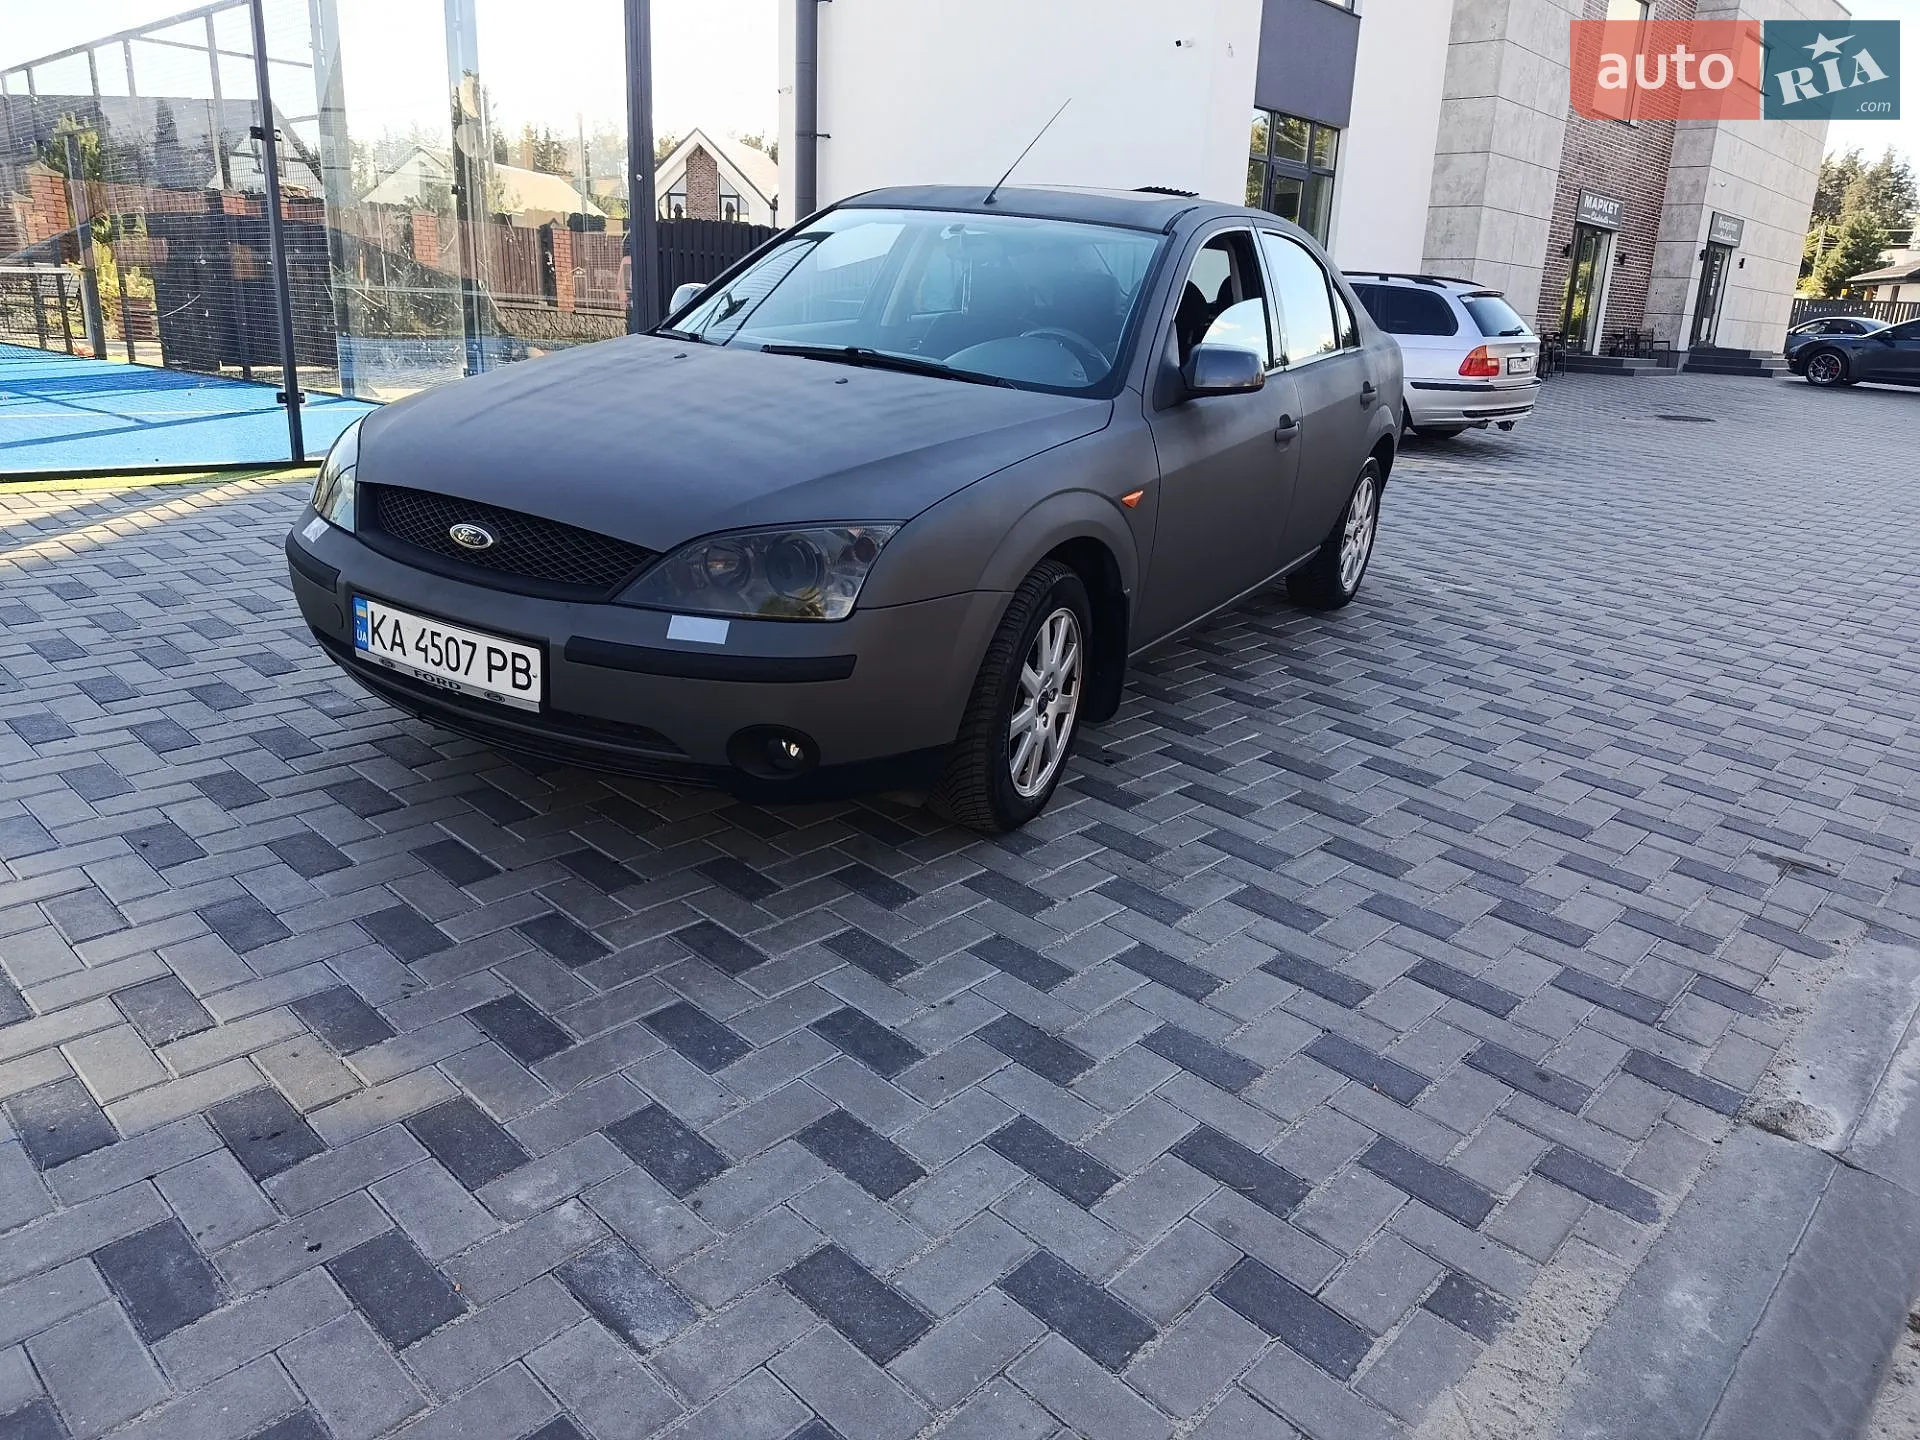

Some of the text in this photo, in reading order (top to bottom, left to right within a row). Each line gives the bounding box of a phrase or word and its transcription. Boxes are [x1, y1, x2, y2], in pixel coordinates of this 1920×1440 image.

[1584, 195, 1620, 216] МАРКЕТ
[356, 629, 368, 643] UA
[370, 611, 532, 691] KA 4507 PB
[413, 669, 462, 690] FORD
